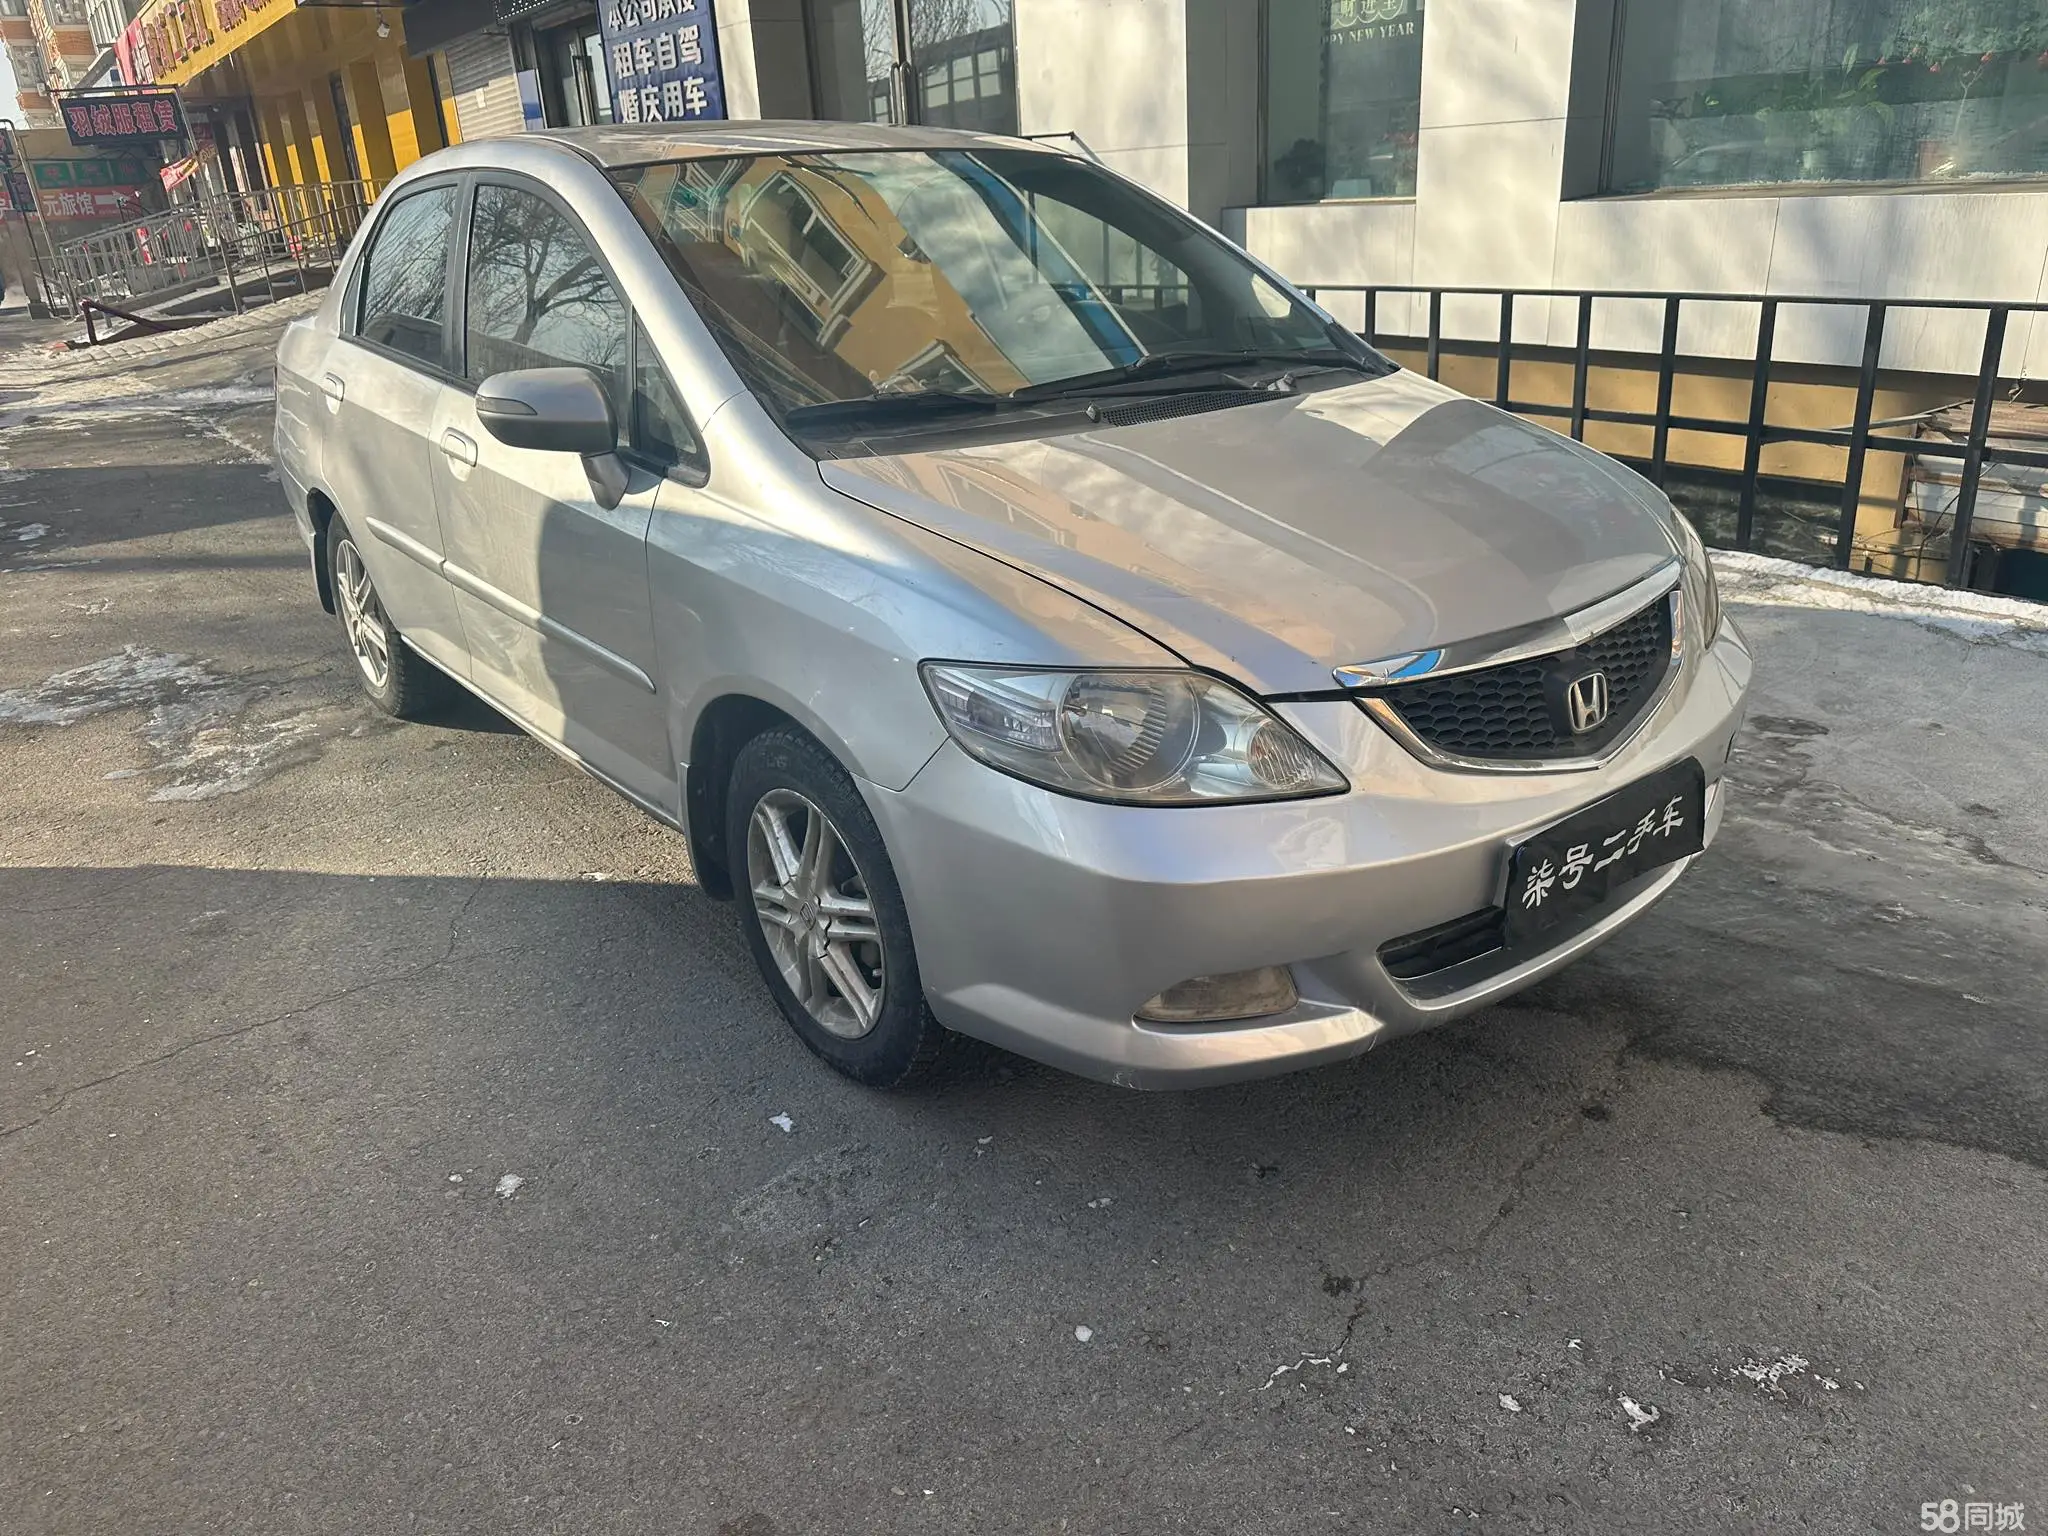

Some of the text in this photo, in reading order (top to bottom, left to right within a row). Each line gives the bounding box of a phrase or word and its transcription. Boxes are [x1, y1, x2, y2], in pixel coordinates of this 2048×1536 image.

[612, 24, 702, 80] 租车自驾
[1349, 28, 1376, 42] NEW
[1380, 22, 1414, 38] YEAR
[66, 99, 178, 137] 羽绒服租赁
[618, 76, 708, 124] 婚庆用车
[1522, 796, 1684, 909] 柒号二手车
